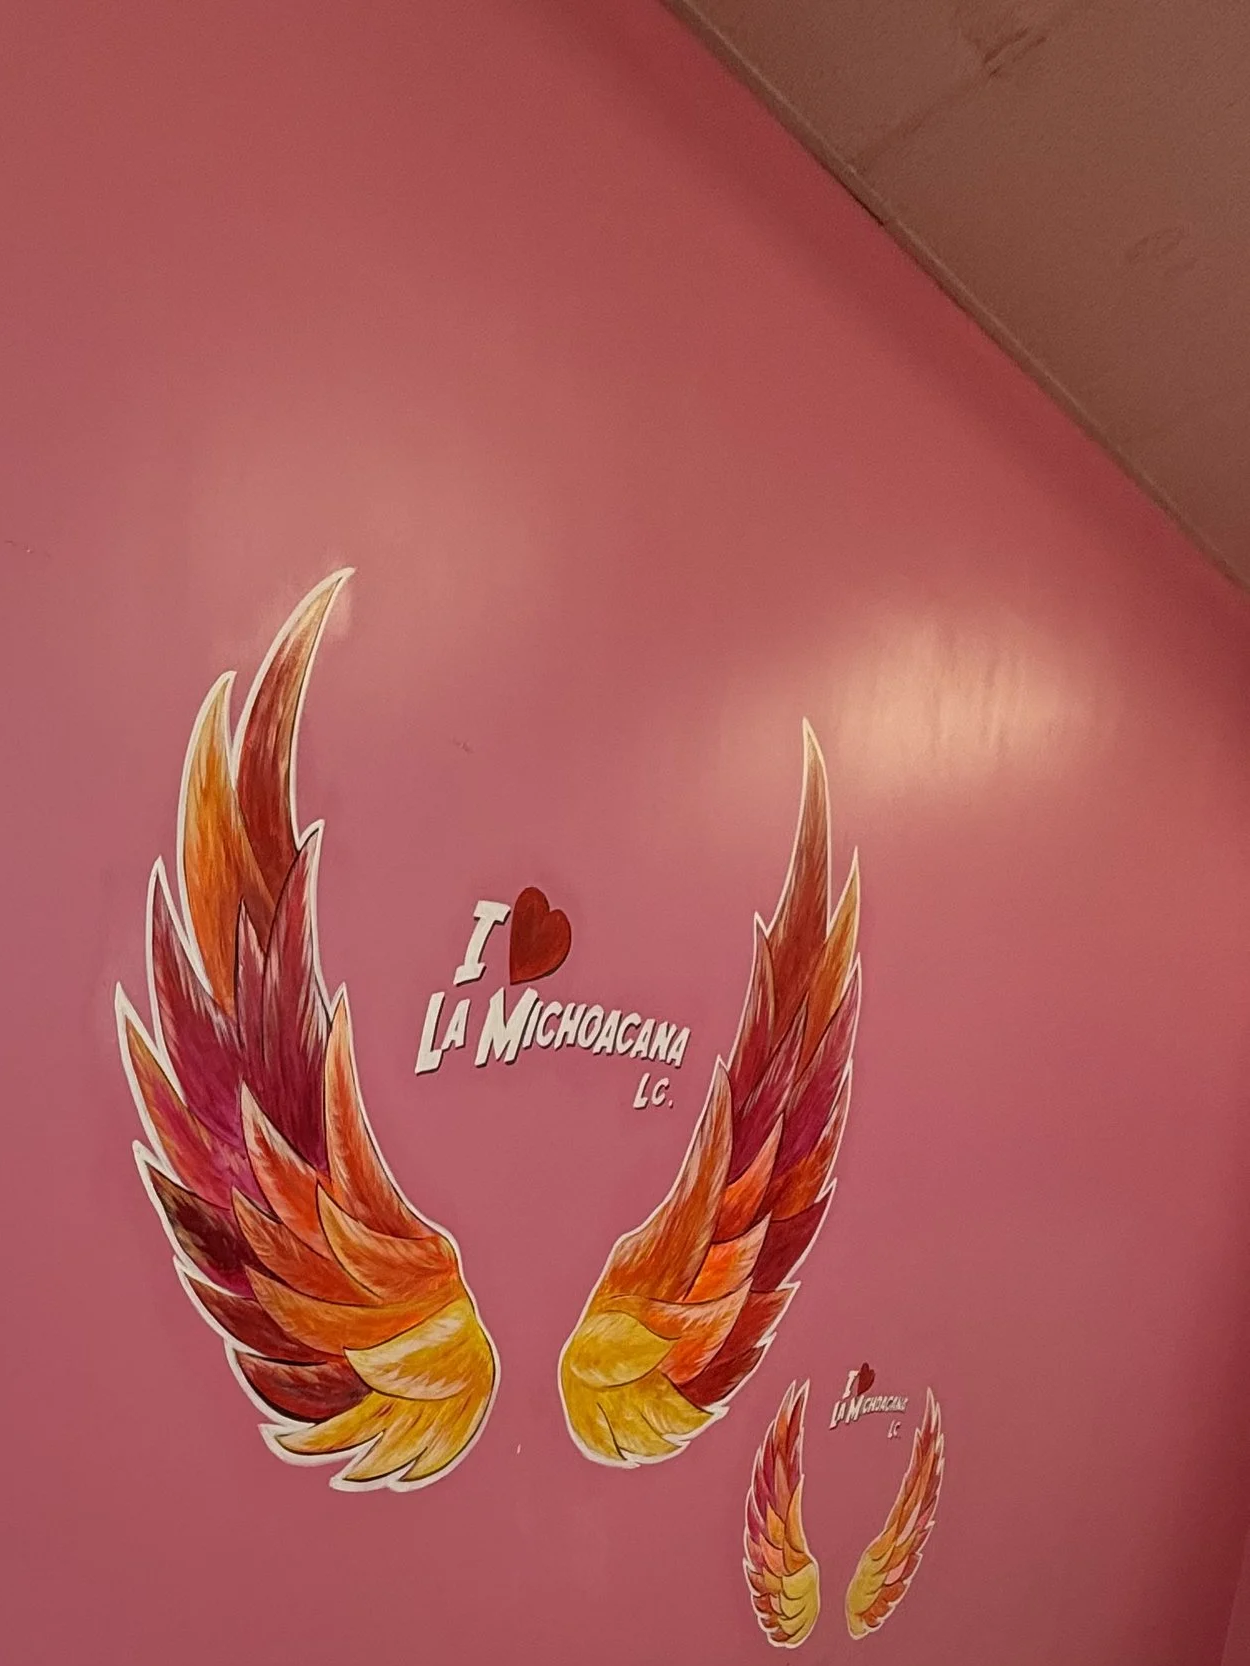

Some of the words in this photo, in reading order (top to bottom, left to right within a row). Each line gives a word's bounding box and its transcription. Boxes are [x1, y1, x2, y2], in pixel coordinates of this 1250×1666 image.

[453, 900, 511, 986] I
[474, 987, 691, 1068] MICHOACANA
[842, 1370, 860, 1400] I
